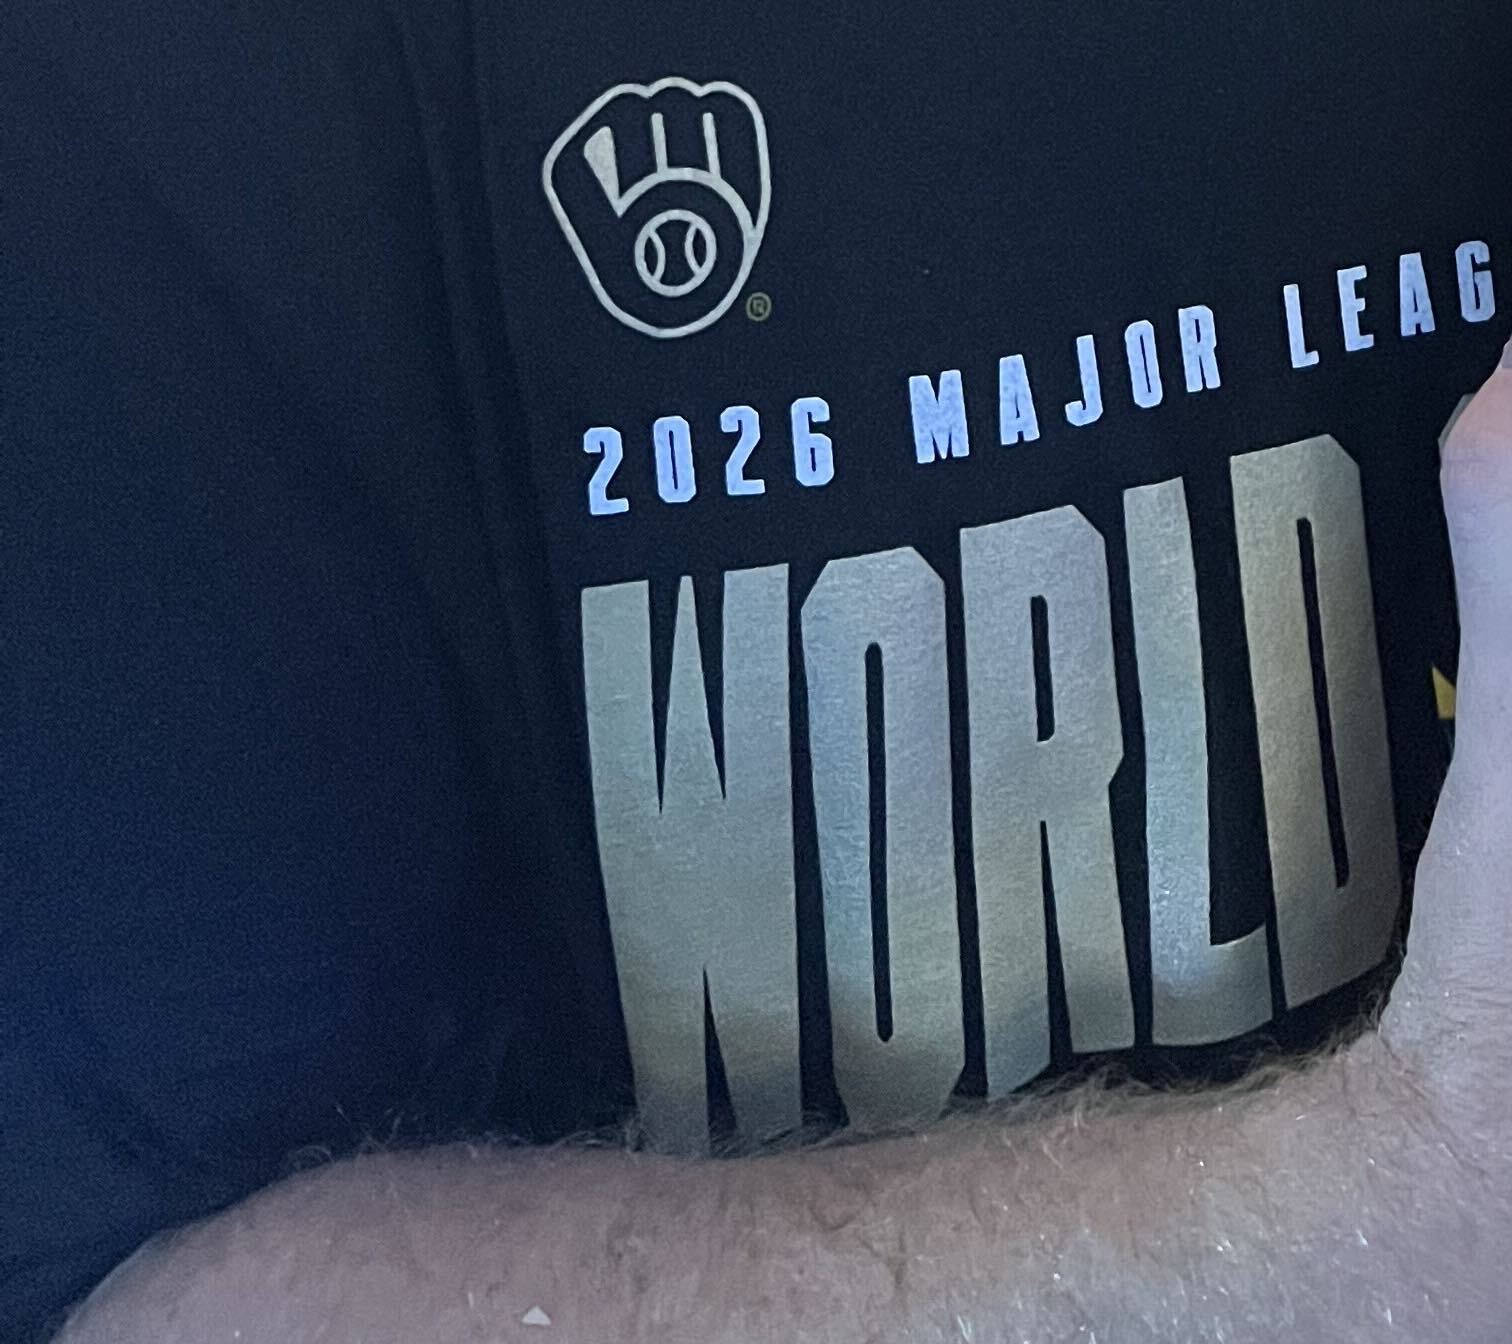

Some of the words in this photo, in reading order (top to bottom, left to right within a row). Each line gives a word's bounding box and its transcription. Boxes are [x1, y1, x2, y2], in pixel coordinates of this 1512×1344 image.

[582, 396, 835, 516] 2026
[909, 304, 1222, 464] MAJOR
[581, 433, 1406, 1158] WORLD
